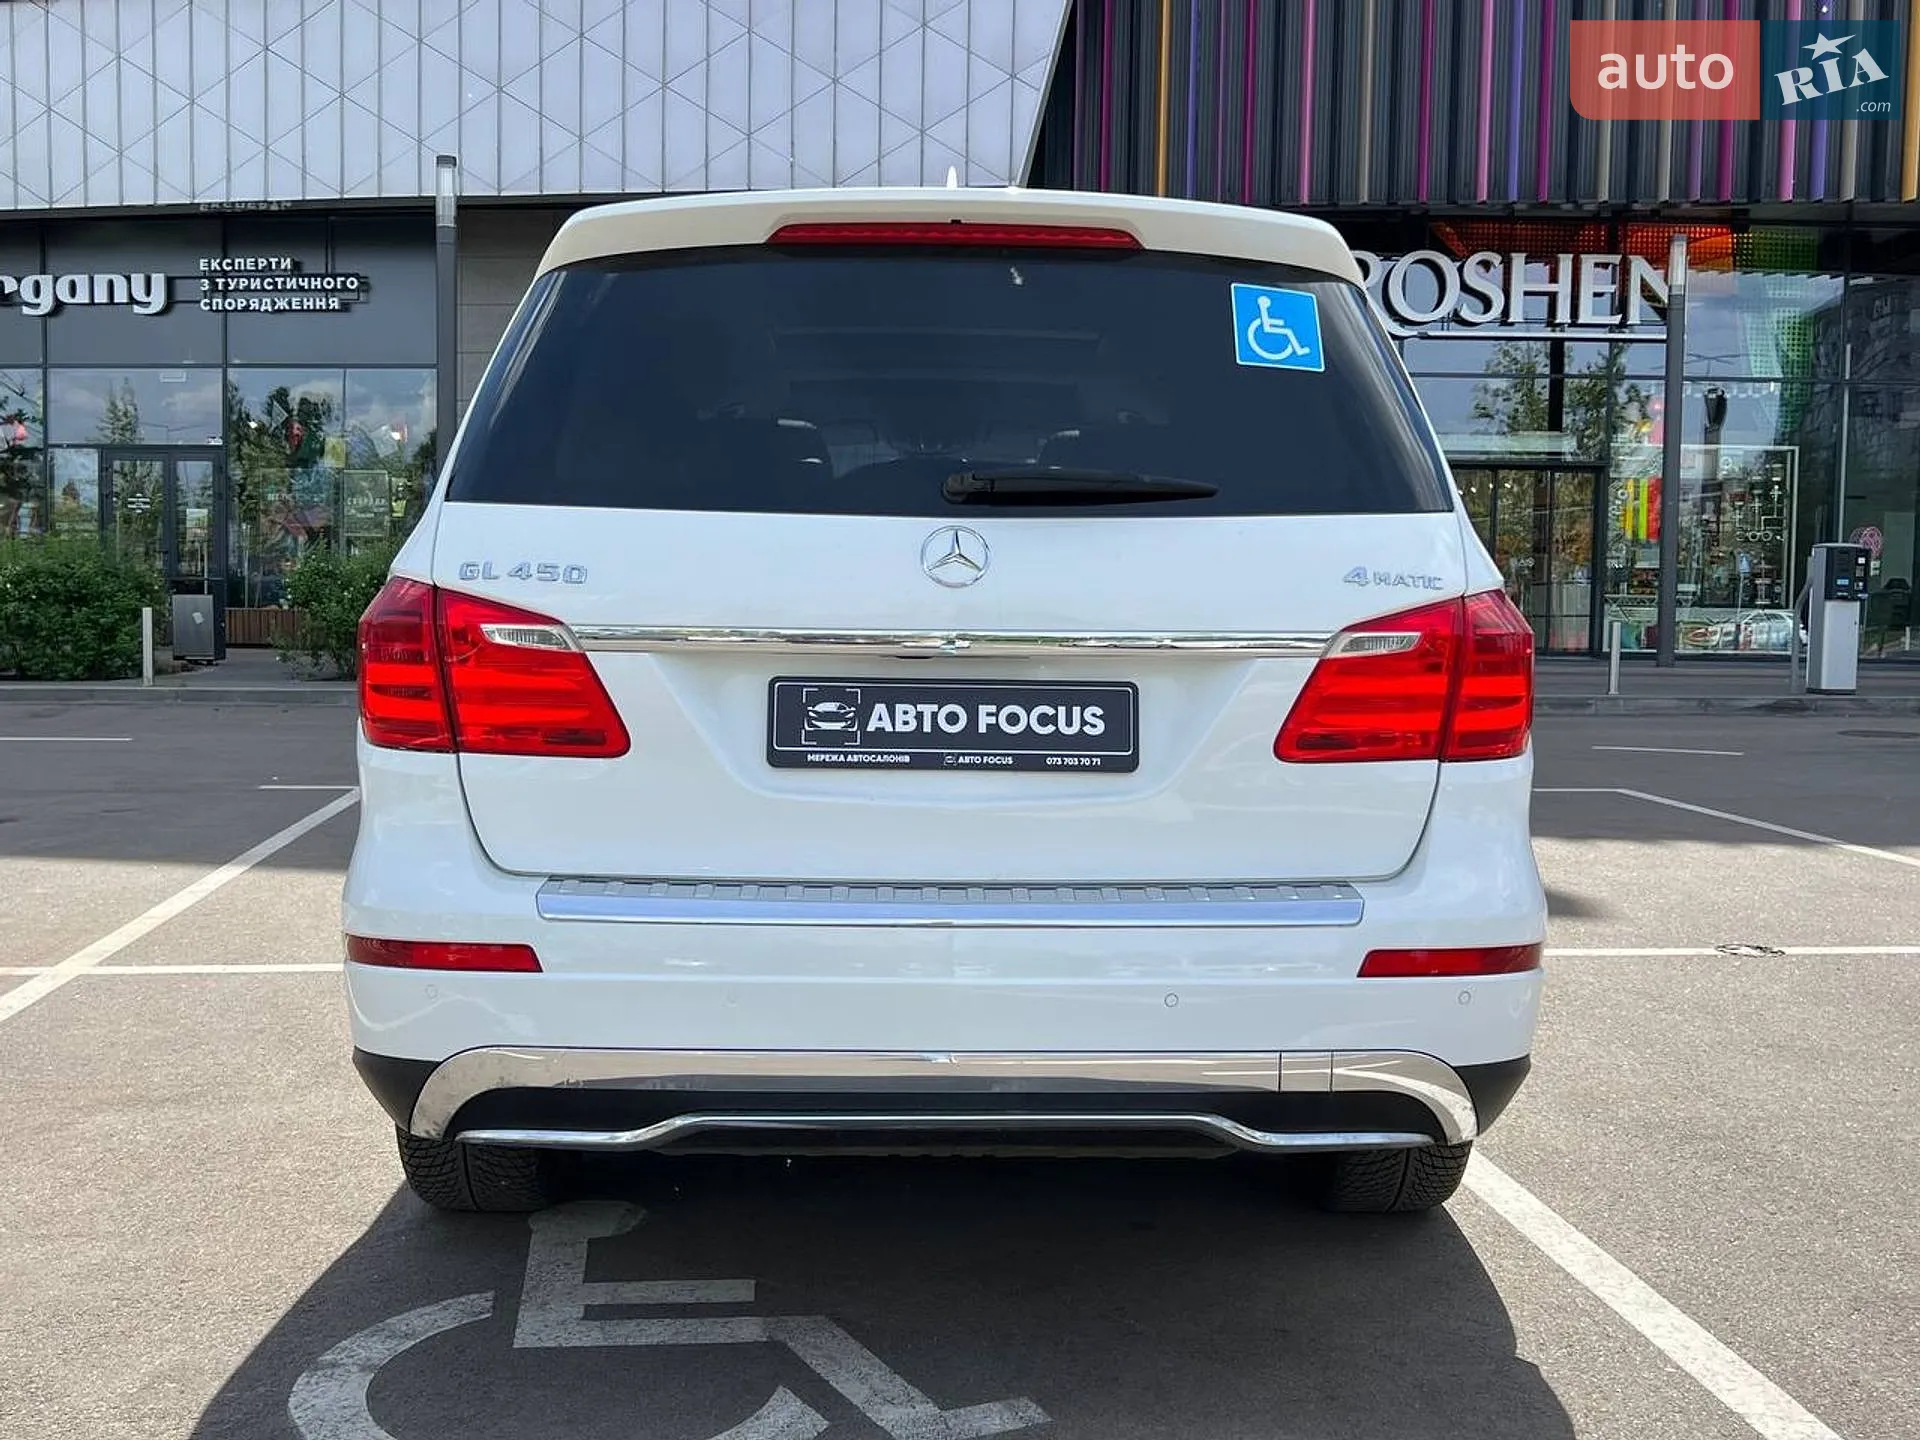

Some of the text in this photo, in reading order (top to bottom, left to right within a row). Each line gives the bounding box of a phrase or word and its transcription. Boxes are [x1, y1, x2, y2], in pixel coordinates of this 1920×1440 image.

[200, 258, 292, 271] ЕКСПЕРТИ
[216, 277, 359, 290] ТУРИСТИЧНОГО
[200, 297, 340, 312] СПОРЯДЖЕННЯ
[458, 561, 588, 585] GL 450
[978, 704, 1106, 736] FOCUS
[807, 753, 910, 764] МЕРЕЖА АВТОСАЛОНІВ
[983, 756, 1013, 765] FOCUS
[1046, 757, 1061, 766] 073
